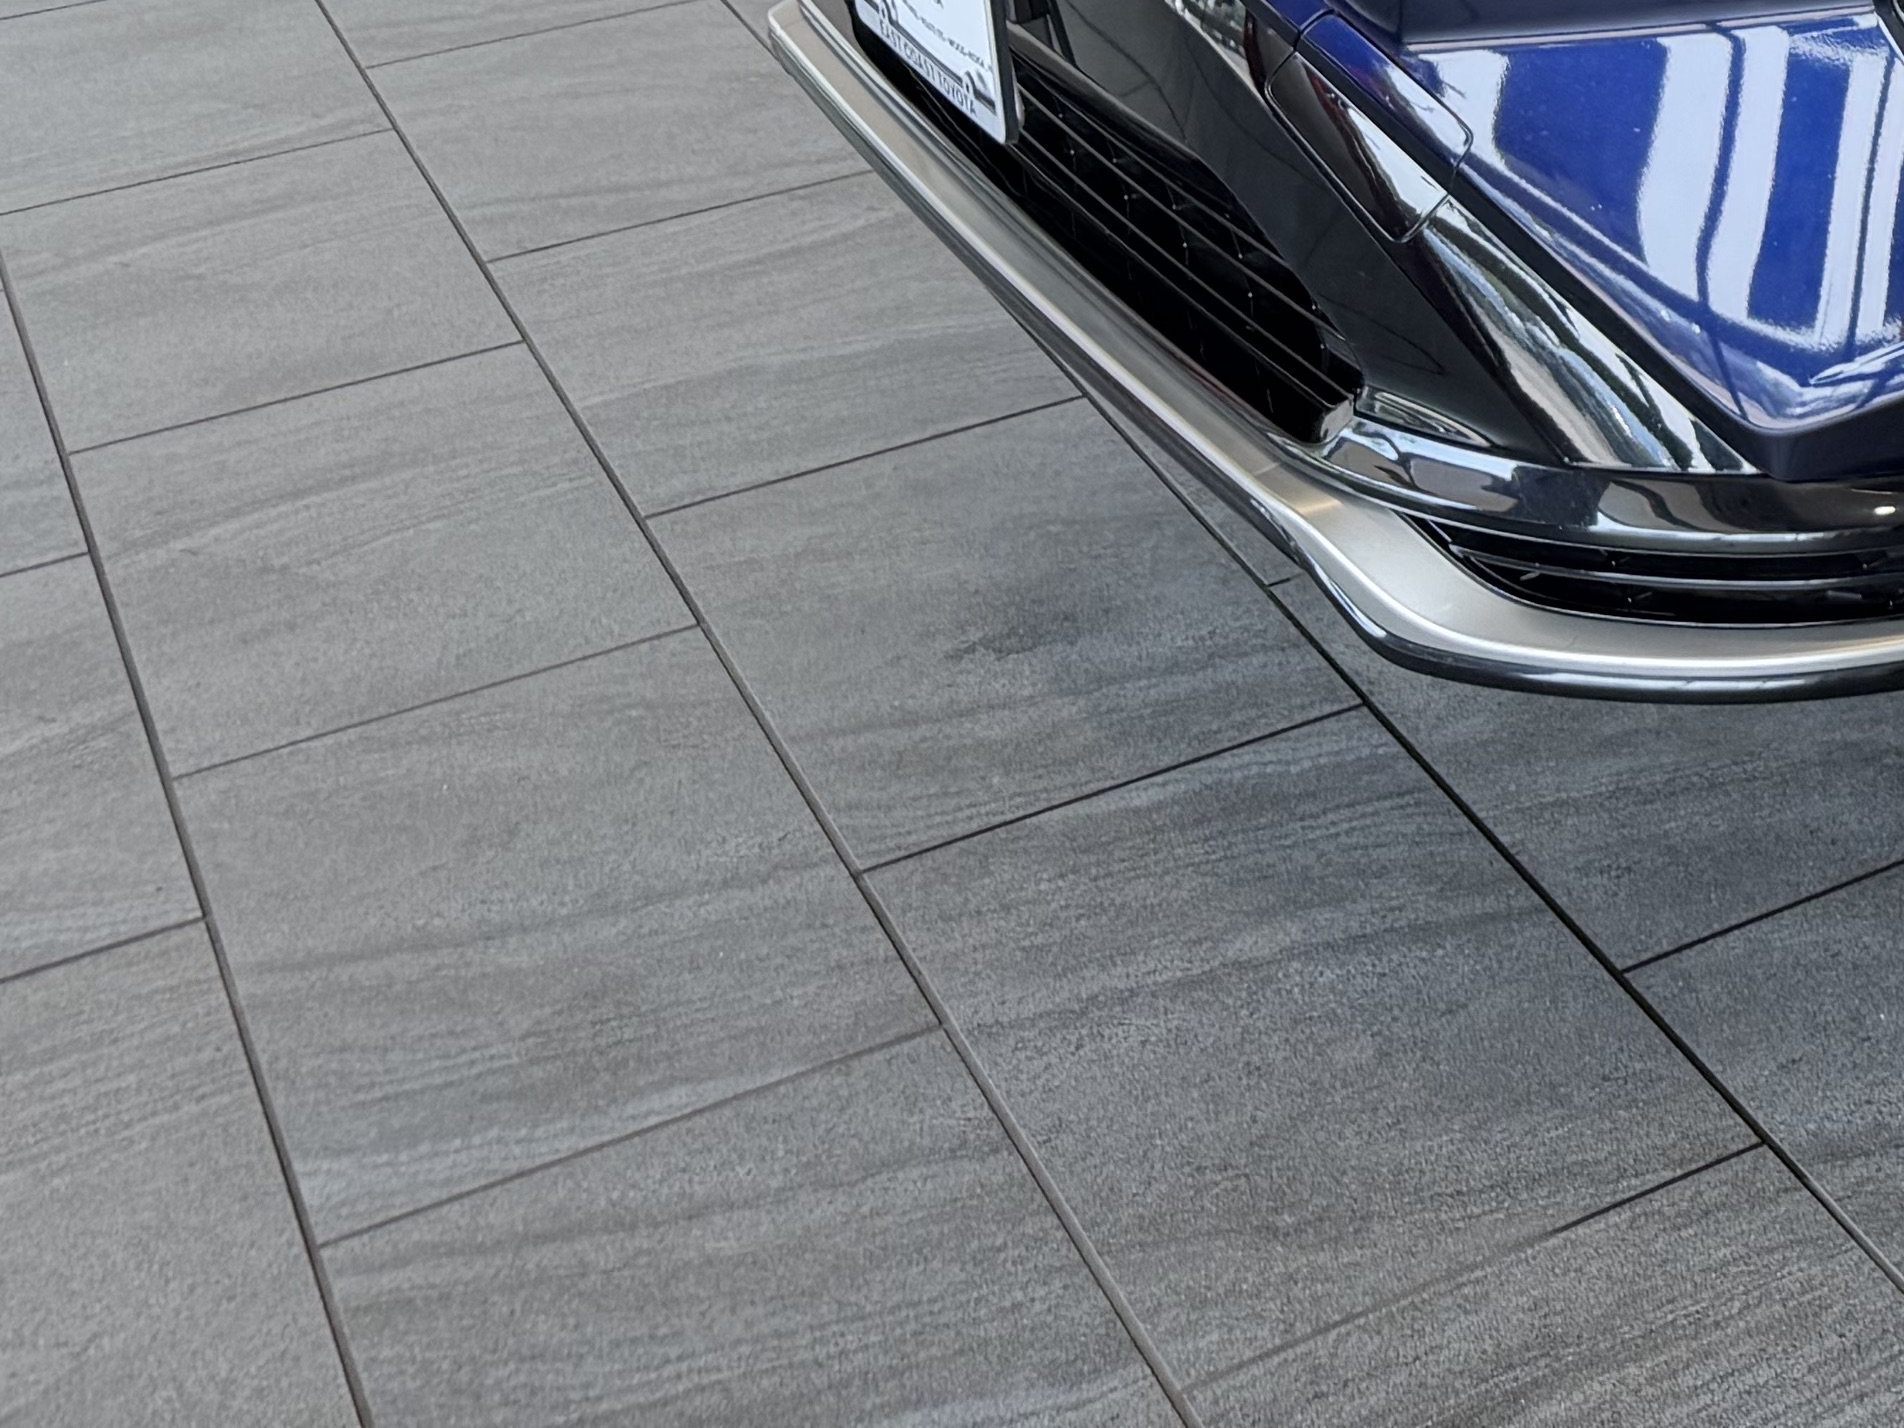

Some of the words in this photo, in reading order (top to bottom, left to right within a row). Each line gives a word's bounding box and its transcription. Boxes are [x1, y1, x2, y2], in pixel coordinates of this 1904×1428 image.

[878, 20, 903, 56] EAST
[903, 42, 936, 83] COAST
[938, 69, 978, 116] TOYOTA
